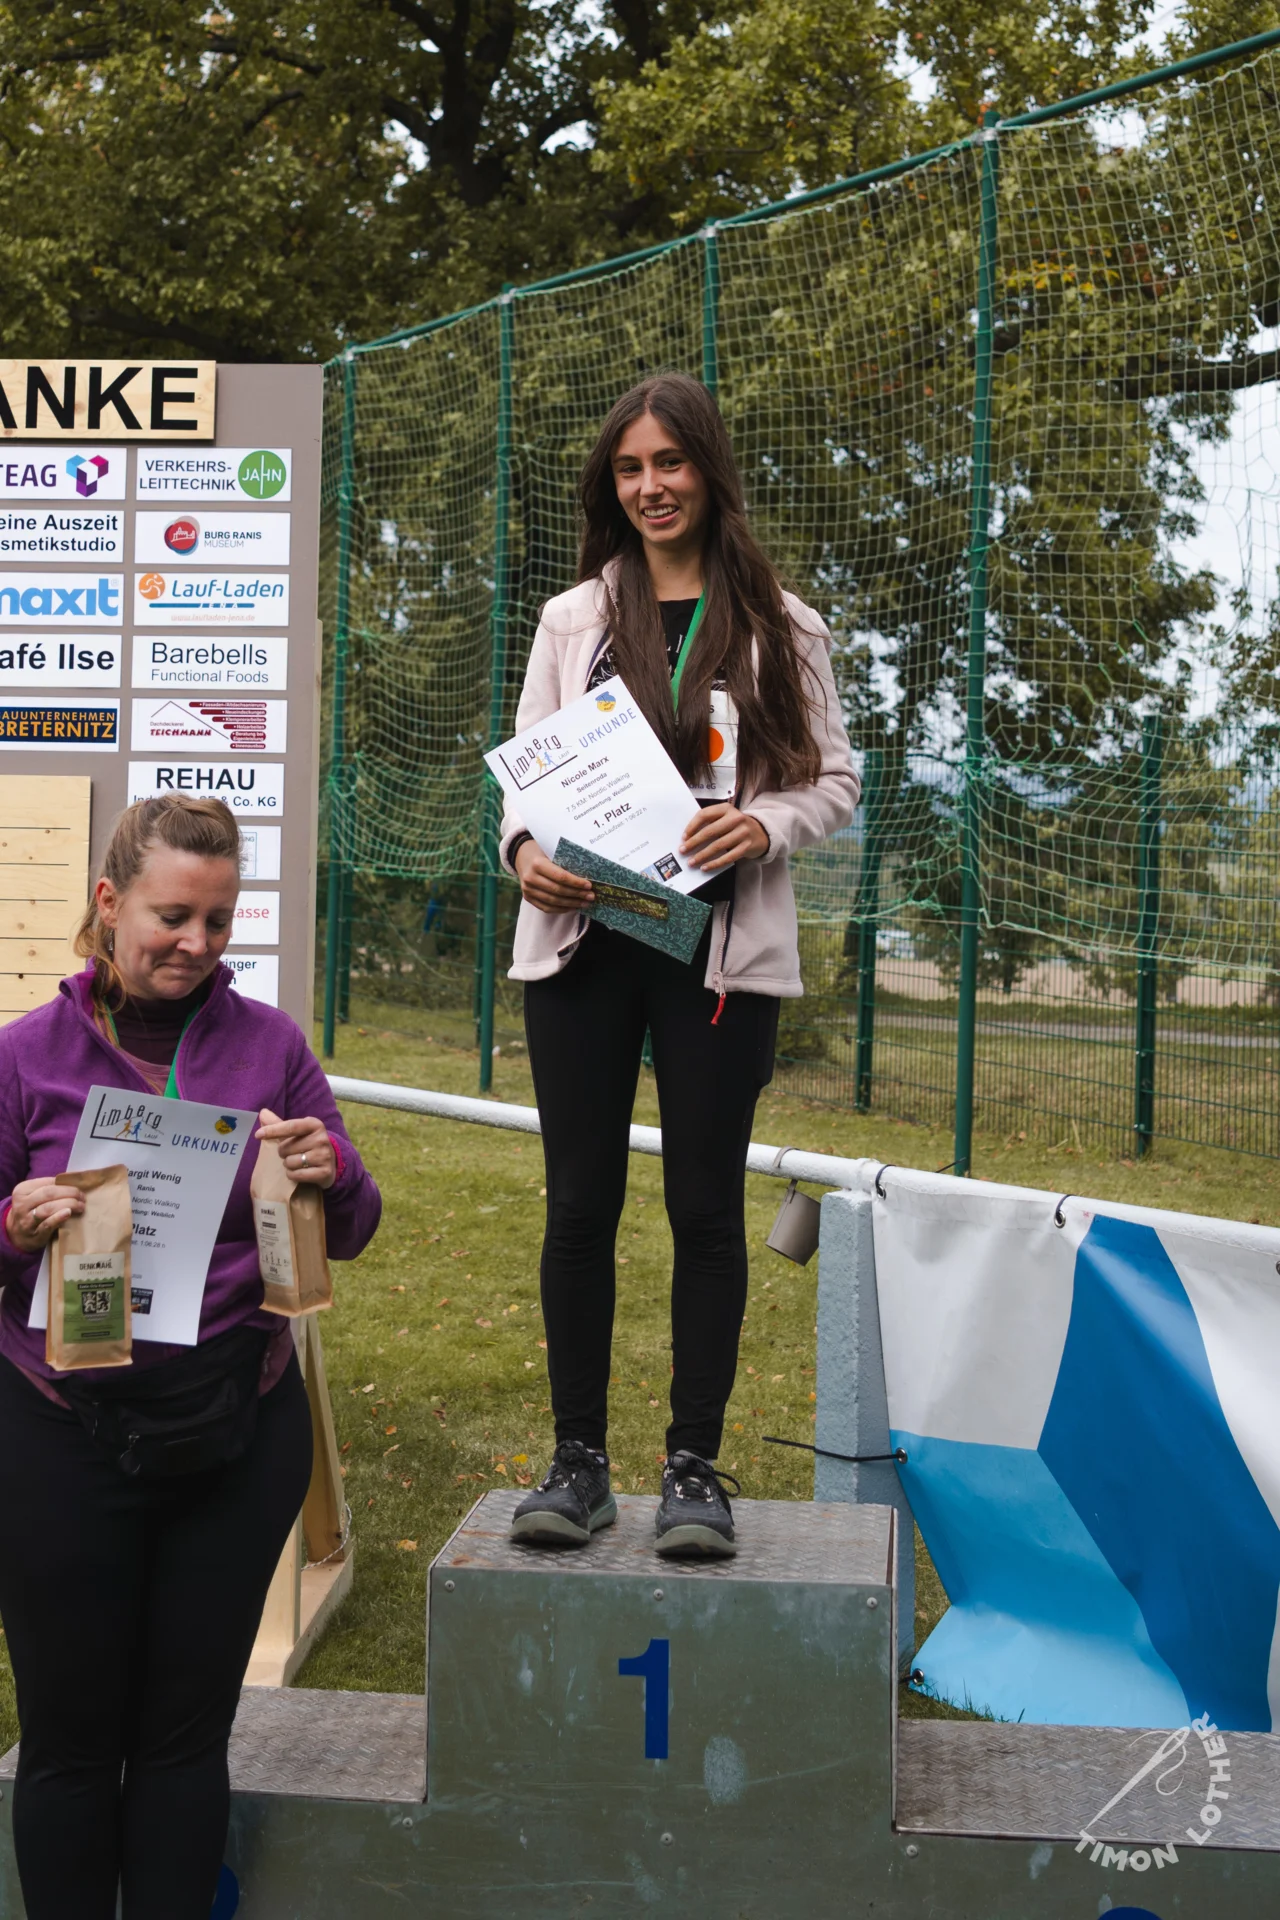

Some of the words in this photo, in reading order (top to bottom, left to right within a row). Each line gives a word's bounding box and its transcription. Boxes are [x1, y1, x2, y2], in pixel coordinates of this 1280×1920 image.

[145, 460, 232, 472] VERKEHRS-
[0, 464, 57, 487] EAG
[139, 478, 236, 490] LEITTECHNIK
[43, 514, 118, 531] Auszeit
[0, 536, 116, 551] smetikstudio
[204, 531, 230, 540] BURG
[232, 532, 262, 540] RANIS
[204, 540, 244, 548] MUSEUM
[171, 579, 284, 599] Lauf-Laden
[58, 643, 115, 671] Ilse
[151, 642, 268, 666] Barebells
[151, 668, 222, 682] Functional
[226, 670, 269, 683] Foods
[150, 728, 212, 737] TEICHMANN
[578, 707, 637, 748] URKUNDE
[156, 767, 255, 791] REHAU
[560, 768, 588, 788] Nicole
[587, 756, 610, 772] Marx
[588, 786, 608, 800] Nordic
[606, 772, 631, 788] Walking
[233, 796, 254, 807] Co.
[257, 796, 277, 807] KG
[593, 819, 605, 829] 1.
[604, 802, 632, 822] Platz
[233, 907, 270, 919] asse
[171, 1133, 239, 1156] URKUNDE
[127, 1168, 150, 1180] argit
[151, 1170, 182, 1184] Wenig
[136, 1184, 156, 1192] Ranis
[154, 1199, 181, 1210] Walking
[618, 1638, 670, 1759] 1
